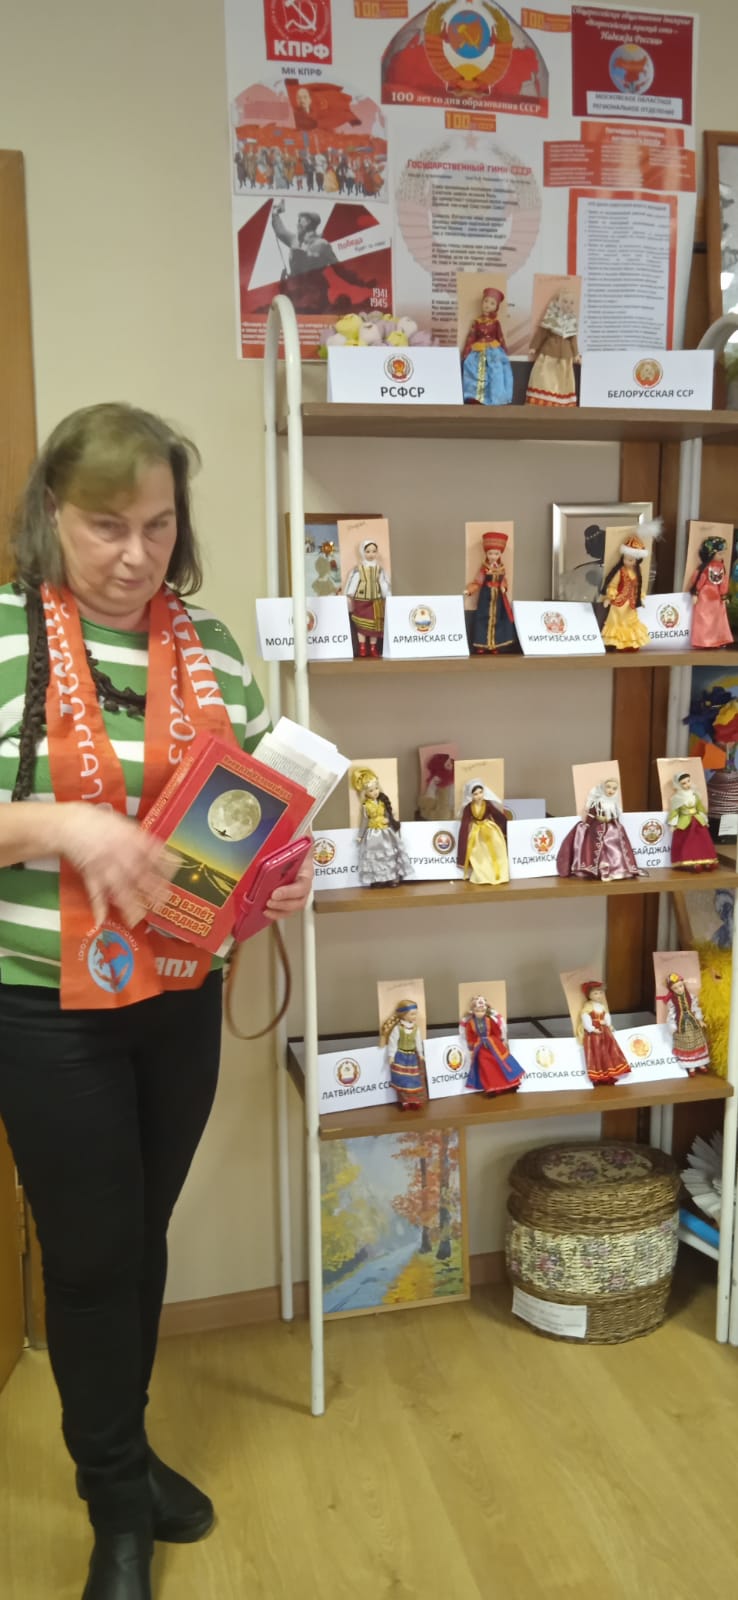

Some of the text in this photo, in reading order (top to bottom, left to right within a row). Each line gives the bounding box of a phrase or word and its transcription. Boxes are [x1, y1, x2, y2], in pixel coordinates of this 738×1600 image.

[274, 39, 330, 60] КПРФ
[281, 67, 322, 77] МК КПРФ
[391, 91, 541, 113] 100 лет со дня образования СССР
[372, 287, 388, 298] 1941
[370, 298, 388, 308] 1945
[380, 386, 425, 398] РСФСР
[607, 389, 694, 399] БЕЛОРУССКАЯ ССР
[265, 635, 349, 646] МОЛДСКАЯ ССР
[393, 633, 463, 644] АРМЯНСКАЯ ССР
[528, 633, 598, 643] КИРГИЗСКАЯ ССР
[408, 856, 457, 865] ГРУЗИНСКА
[512, 854, 556, 864] ТАДЖИКСК
[646, 858, 661, 867] ССР
[181, 899, 215, 924] взлёт,
[630, 1057, 666, 1068] АИНСКАЯ
[431, 1071, 469, 1085] ЭСТОНСКА
[570, 1070, 586, 1078] ССР
[322, 1082, 377, 1100] ЛАТВИЙСКАЯ
